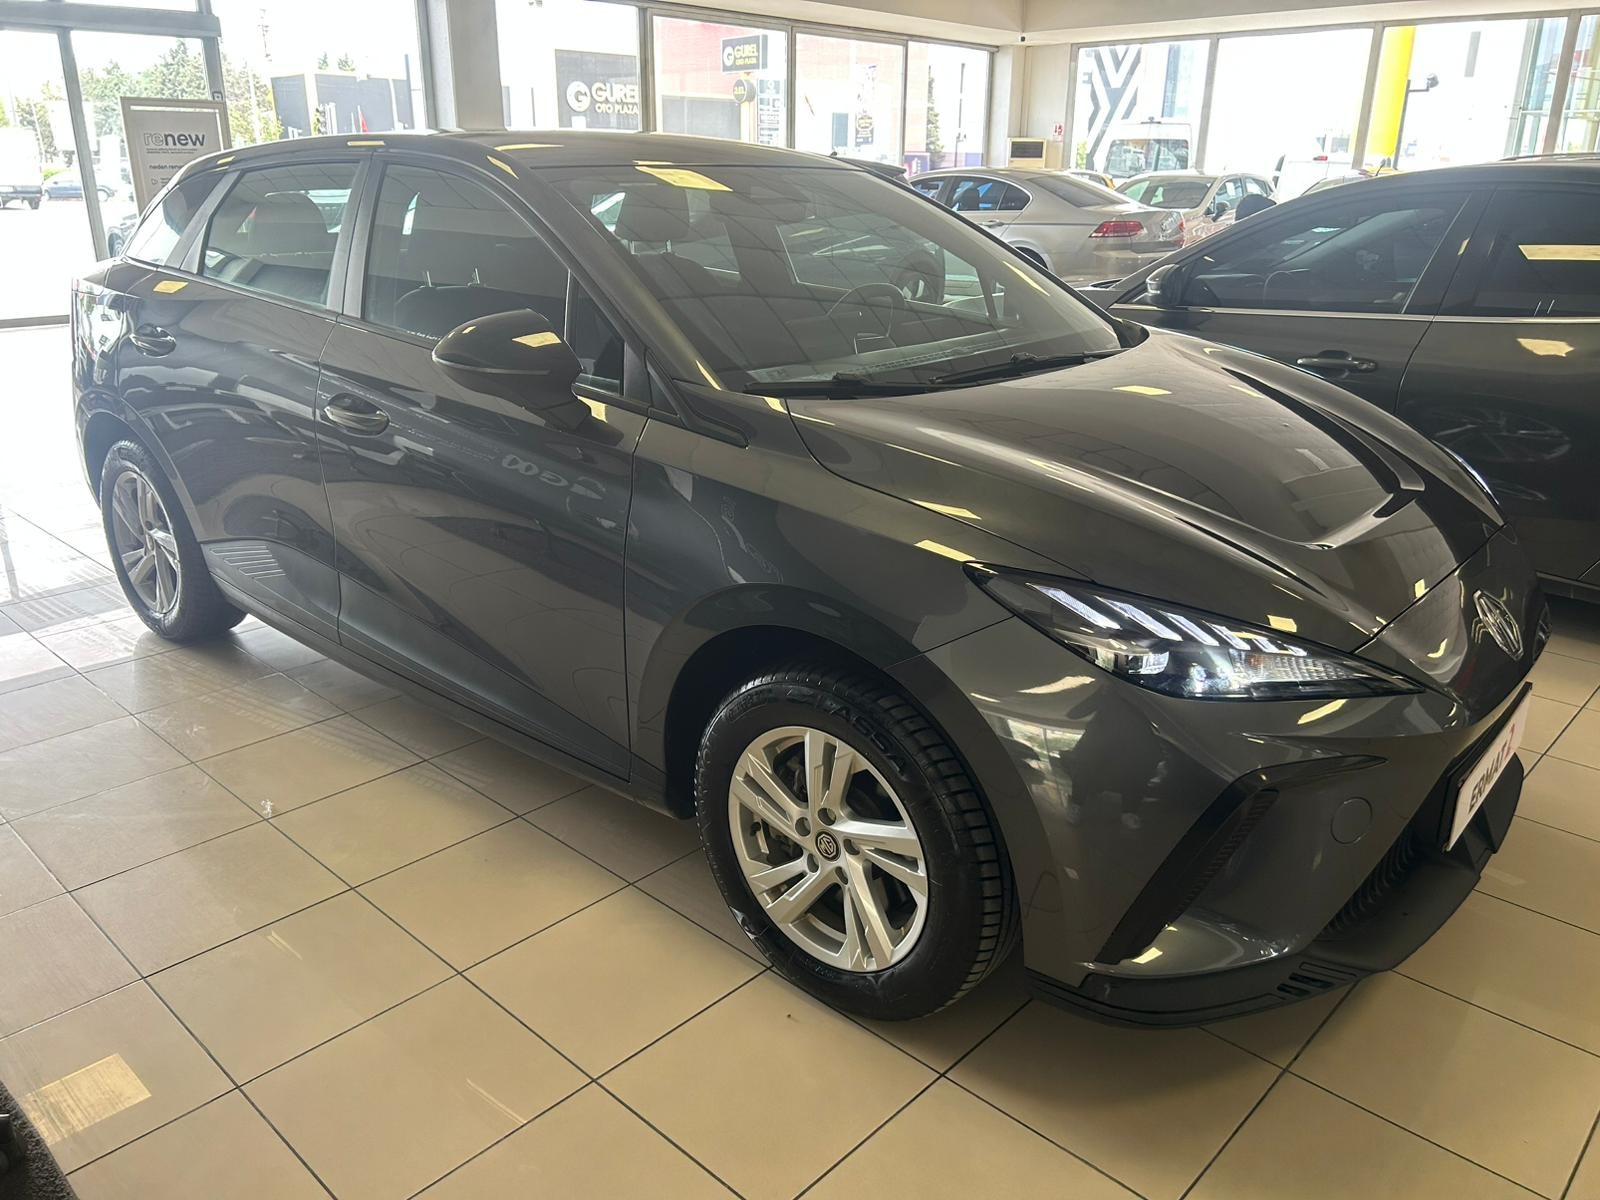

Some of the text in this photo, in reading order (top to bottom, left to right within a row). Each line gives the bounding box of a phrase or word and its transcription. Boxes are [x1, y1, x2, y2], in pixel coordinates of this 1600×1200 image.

[595, 103, 639, 115] OTO PLAZA
[143, 132, 205, 147] renew
[1467, 739, 1508, 814] ERMAT
[818, 835, 836, 857] MG
